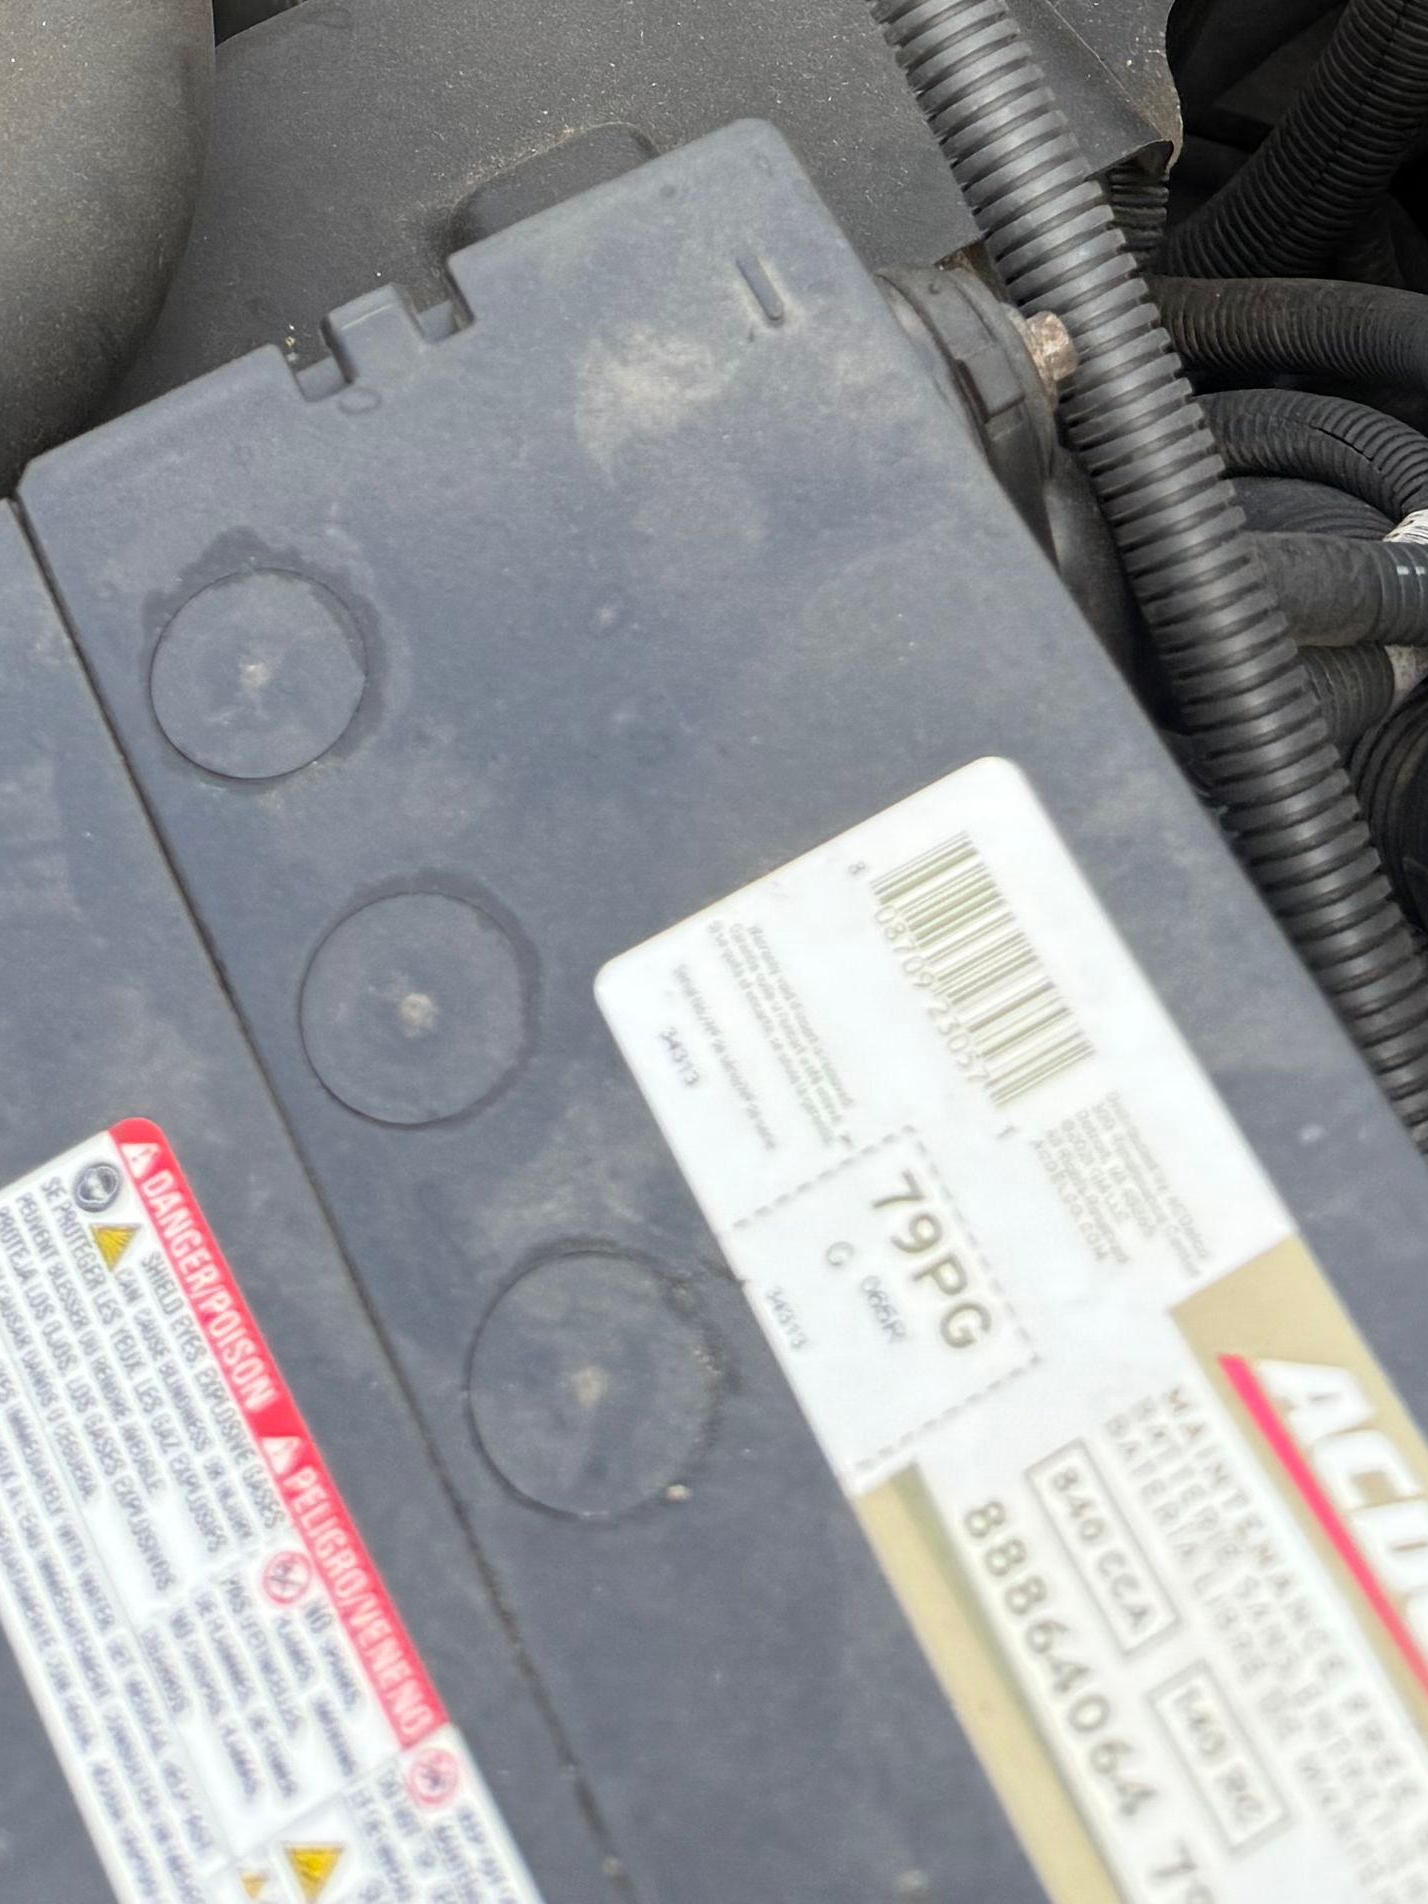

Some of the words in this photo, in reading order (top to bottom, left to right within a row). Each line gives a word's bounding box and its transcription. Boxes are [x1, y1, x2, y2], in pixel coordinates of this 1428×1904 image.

[12, 1193, 60, 1262] PEUVENT
[45, 1262, 92, 1331] BLESSER
[23, 1282, 55, 1320] LOS
[39, 1176, 67, 1204] SE
[90, 1289, 120, 1326] LES
[132, 1378, 163, 1414] LES
[148, 1413, 182, 1455] GAZ
[137, 1173, 280, 1407] DANGER/POISON
[821, 1235, 859, 1272] G
[865, 1170, 995, 1352] 79PG
[64, 1374, 98, 1414] LOS
[131, 1308, 168, 1361] CAUSE
[137, 1251, 185, 1316] SHIELD
[192, 1367, 255, 1462] EXPLOSIVE
[80, 1411, 128, 1476] GASES
[276, 1469, 442, 1738] PELIGRO/VENENO
[954, 1501, 1164, 1816] 88864064
